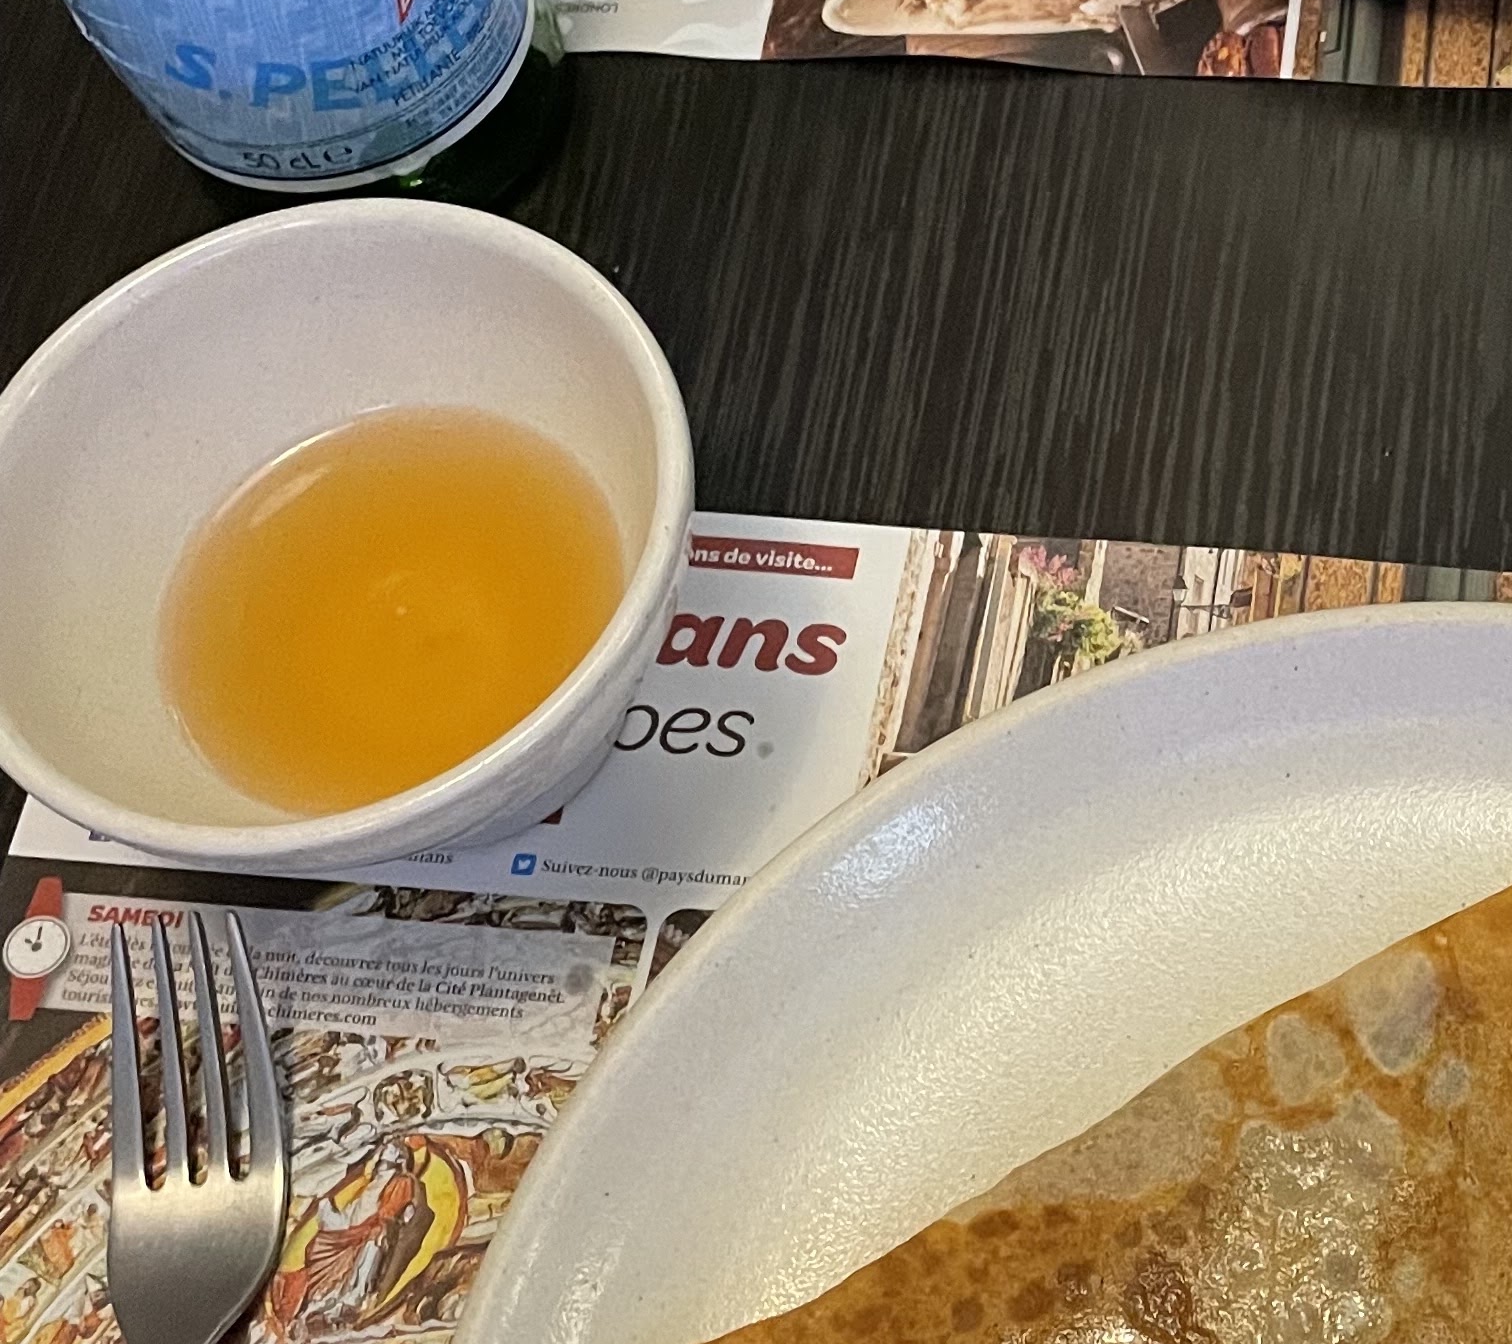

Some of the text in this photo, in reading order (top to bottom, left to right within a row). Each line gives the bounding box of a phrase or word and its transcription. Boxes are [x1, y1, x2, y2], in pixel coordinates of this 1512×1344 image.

[243, 152, 280, 170] 50
[724, 548, 751, 565] de
[656, 613, 847, 676] ans
[541, 857, 638, 880] Suivez-nous
[88, 904, 184, 928] SAMEDI
[305, 951, 555, 985] découvrez l'univers
[435, 980, 466, 995] Cité
[331, 991, 524, 1019] nombreux hébergements
